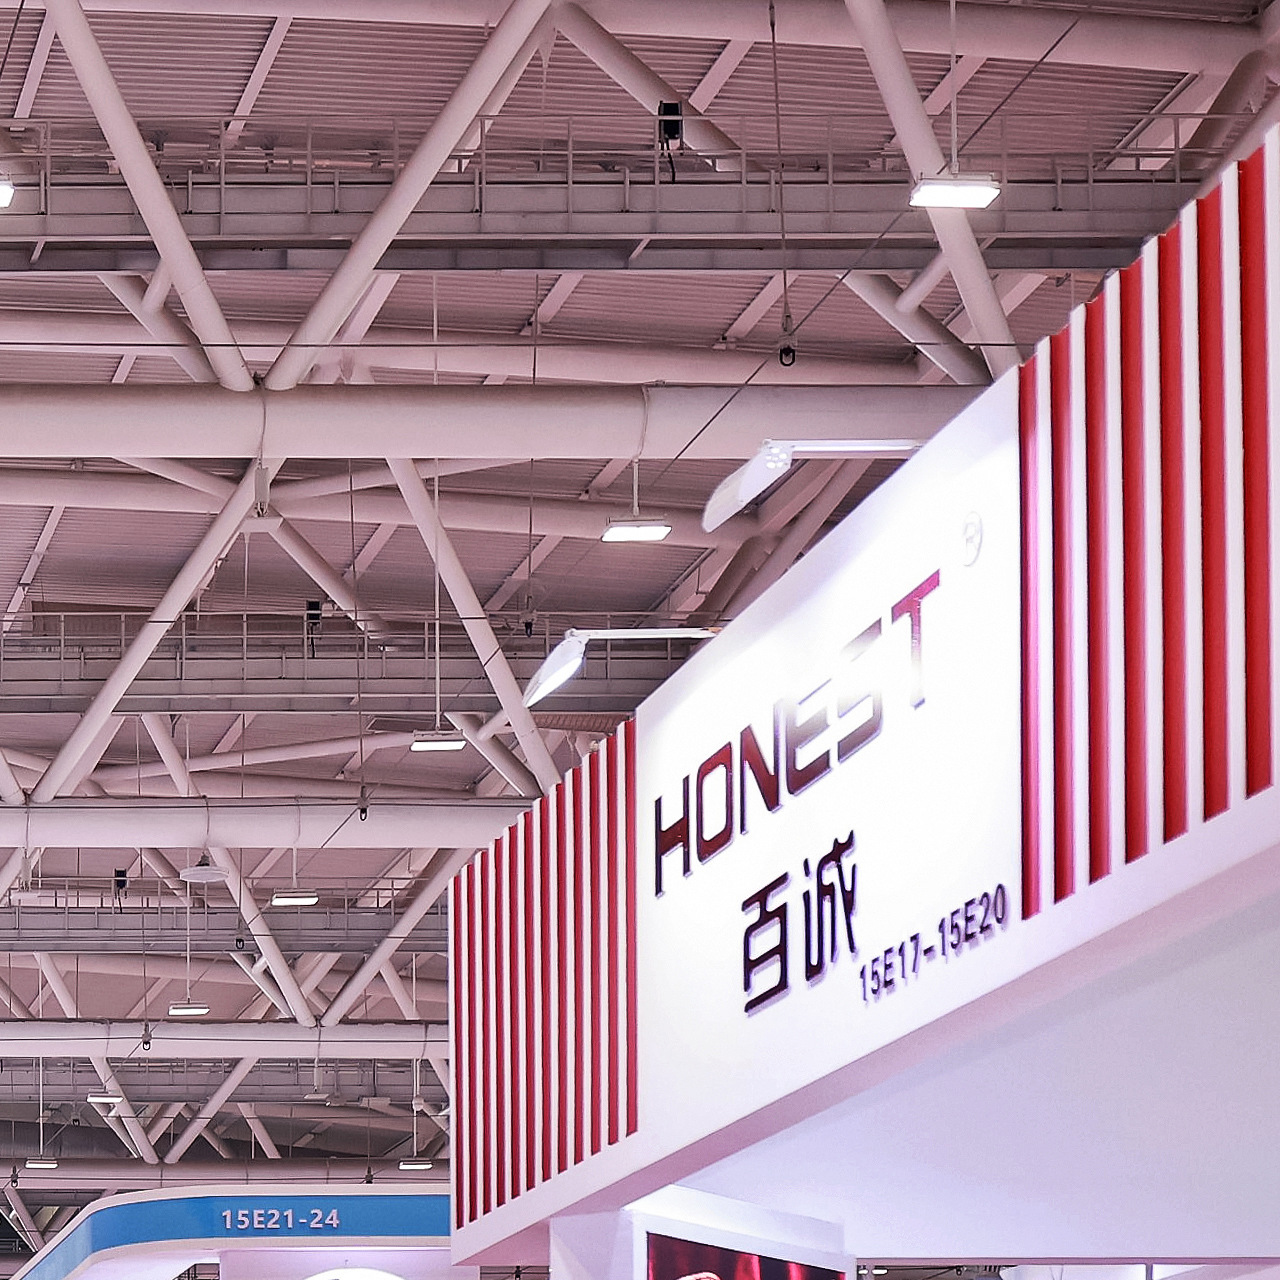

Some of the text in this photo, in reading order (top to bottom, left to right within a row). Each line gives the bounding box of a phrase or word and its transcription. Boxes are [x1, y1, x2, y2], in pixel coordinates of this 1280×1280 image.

[654, 568, 941, 898] HONEST
[742, 830, 858, 1016] 百诚
[859, 883, 1008, 1006] 15E17-15E20
[220, 1207, 340, 1231] 15E21-24
